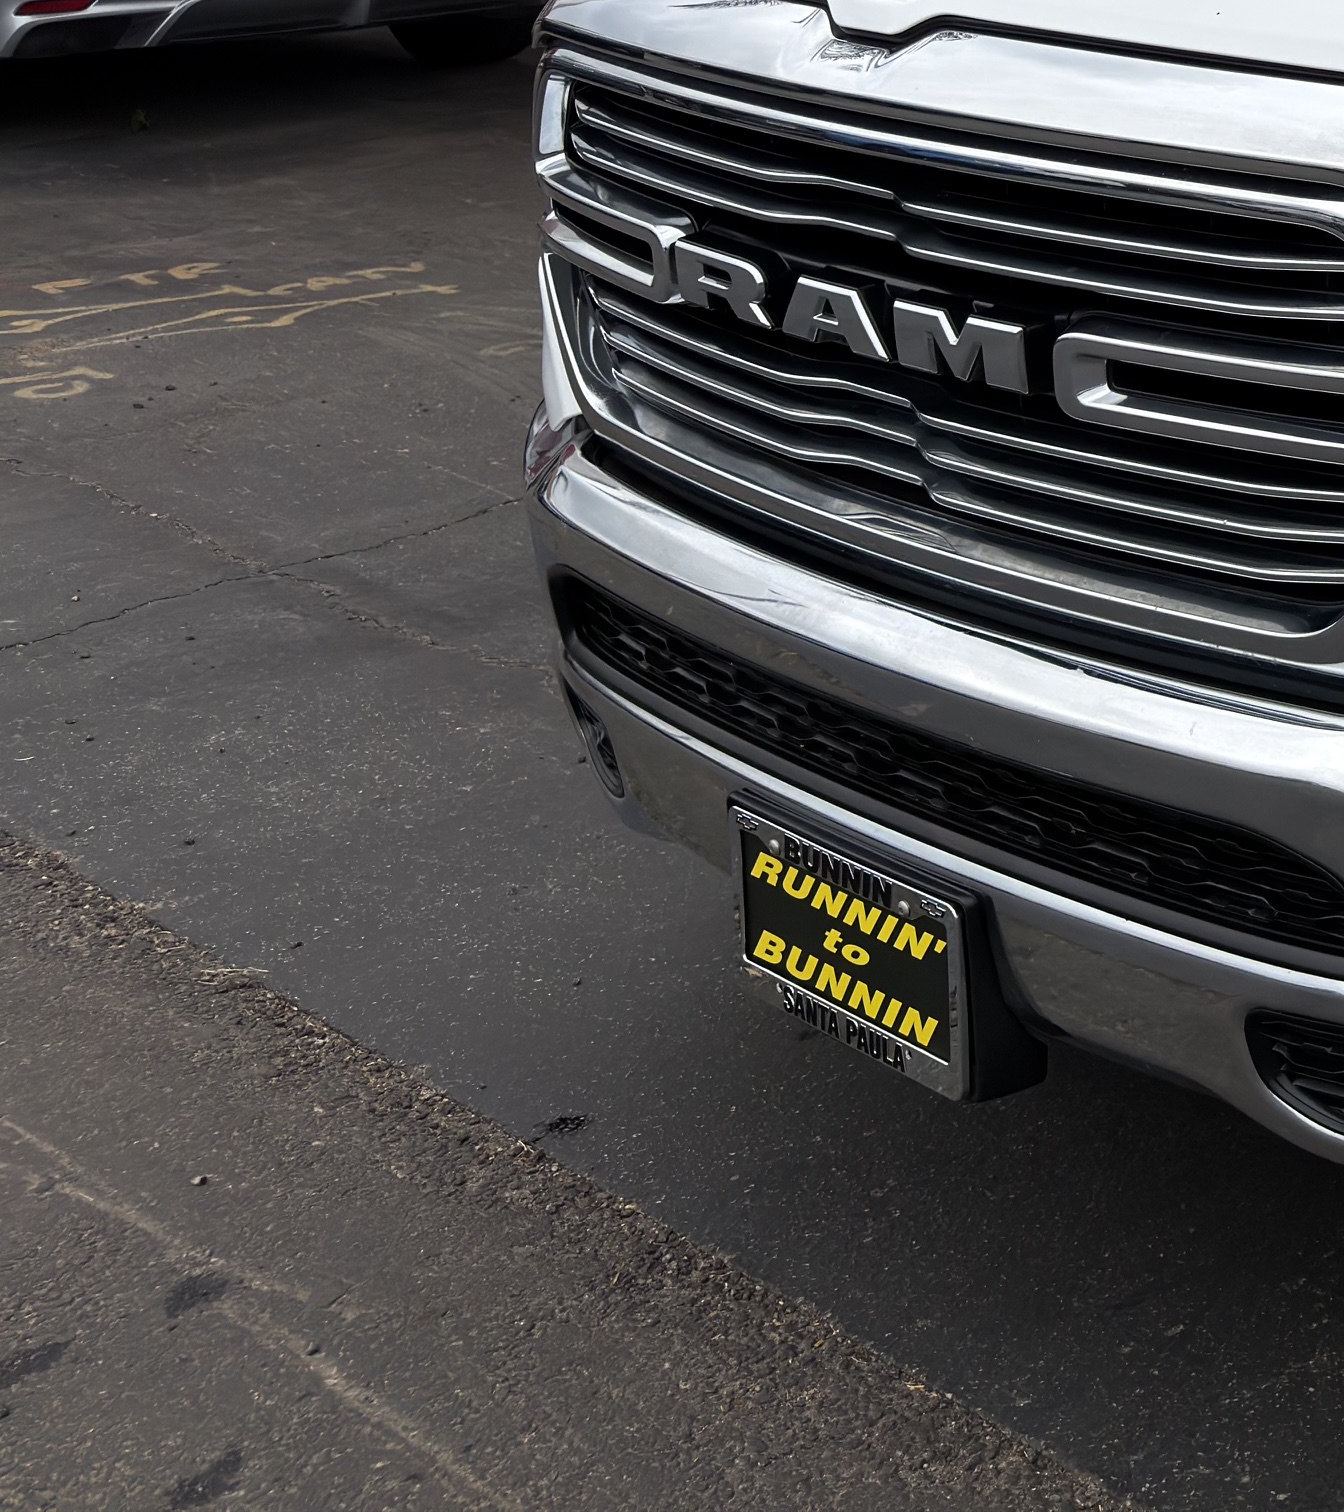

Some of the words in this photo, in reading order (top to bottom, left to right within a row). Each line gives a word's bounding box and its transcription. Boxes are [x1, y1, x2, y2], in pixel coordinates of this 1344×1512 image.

[672, 237, 1031, 395] RAM
[750, 851, 947, 961] RUNNIN'
[783, 833, 893, 906] BUNNIN
[752, 929, 939, 1048] BUNNIN
[822, 928, 871, 966] to
[783, 986, 840, 1036] SANTA
[846, 1018, 906, 1072] PAULA
